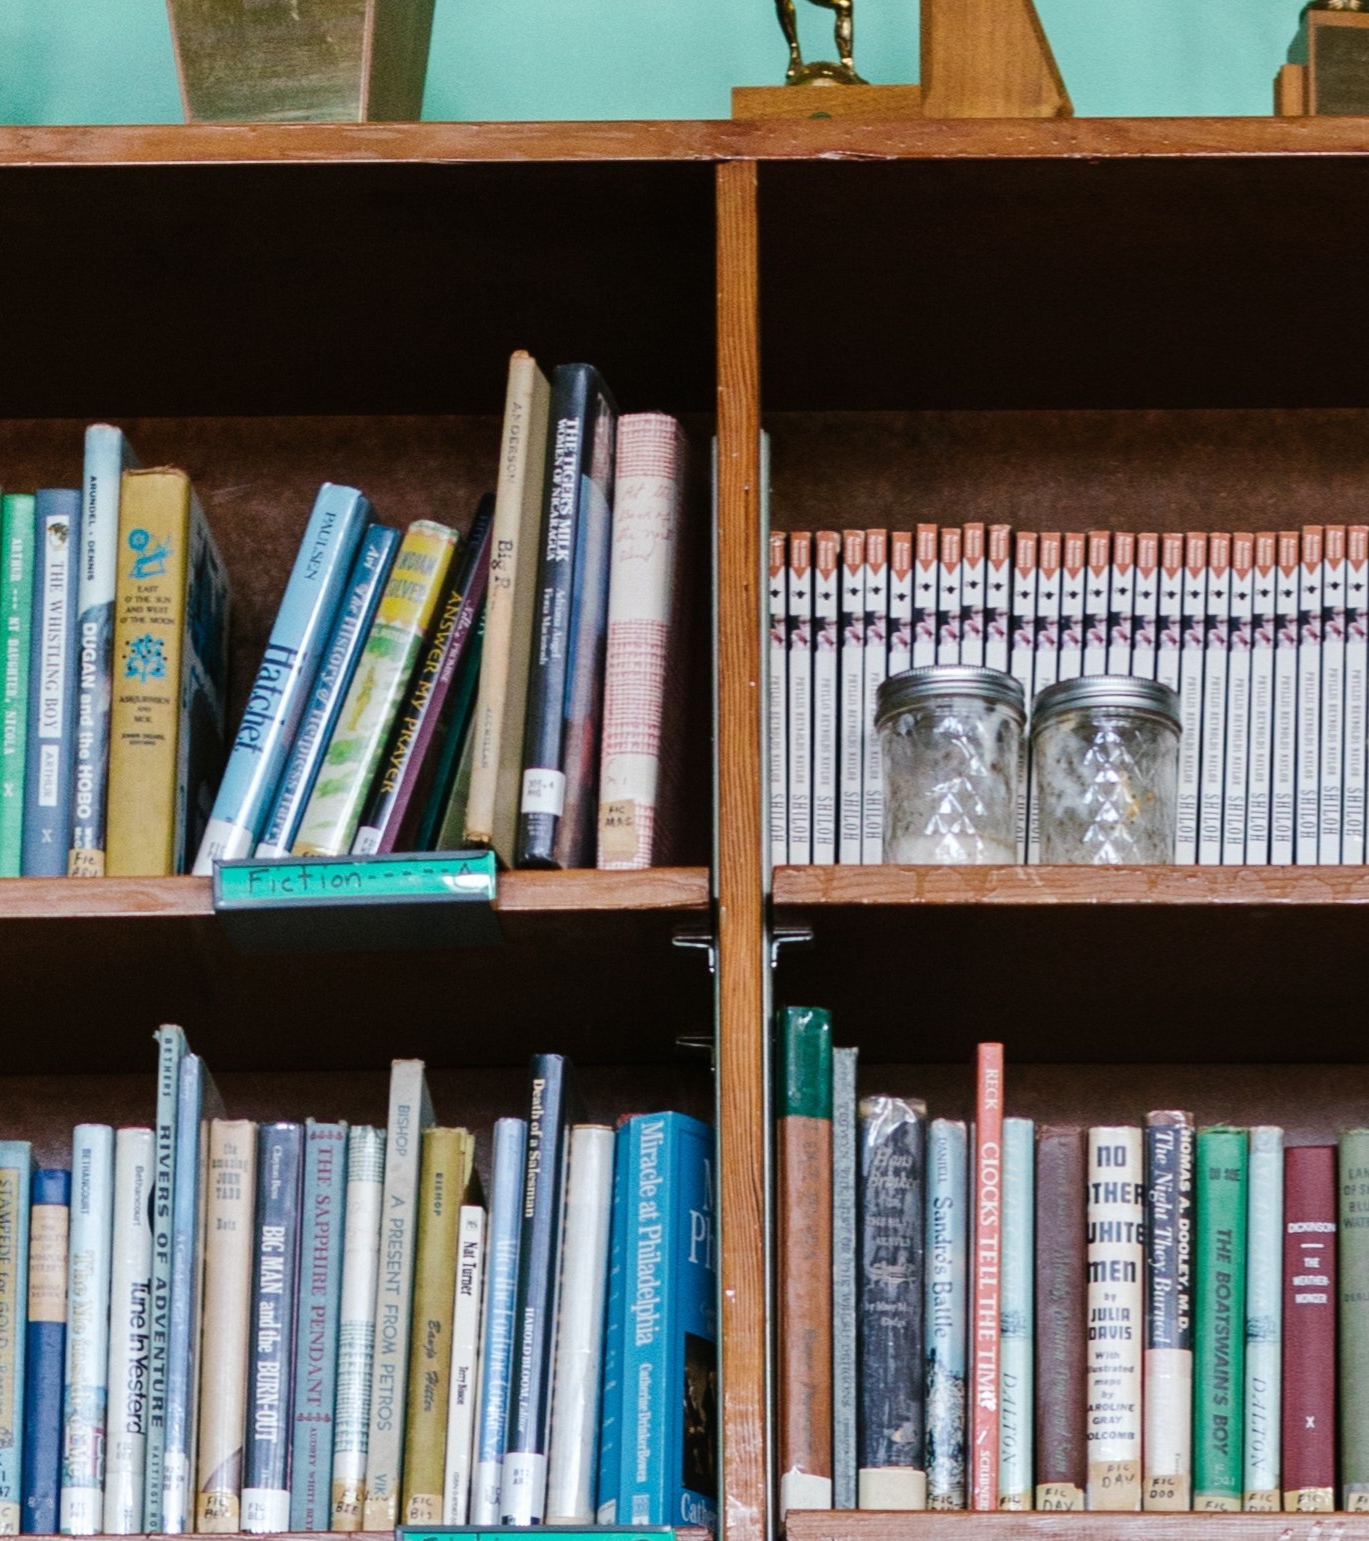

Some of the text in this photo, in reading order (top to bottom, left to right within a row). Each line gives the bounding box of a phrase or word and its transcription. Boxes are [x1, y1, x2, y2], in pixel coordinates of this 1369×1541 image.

[76, 622, 97, 819] DUGAN and the HOBO
[233, 642, 299, 753] Hatchet
[816, 795, 832, 845] SHILOH
[843, 791, 859, 841] SHILOH
[247, 865, 363, 894] Fiction
[630, 1119, 664, 1346] Miracle at Philadelphia
[978, 1142, 998, 1342] CLOCKS TELL THE
